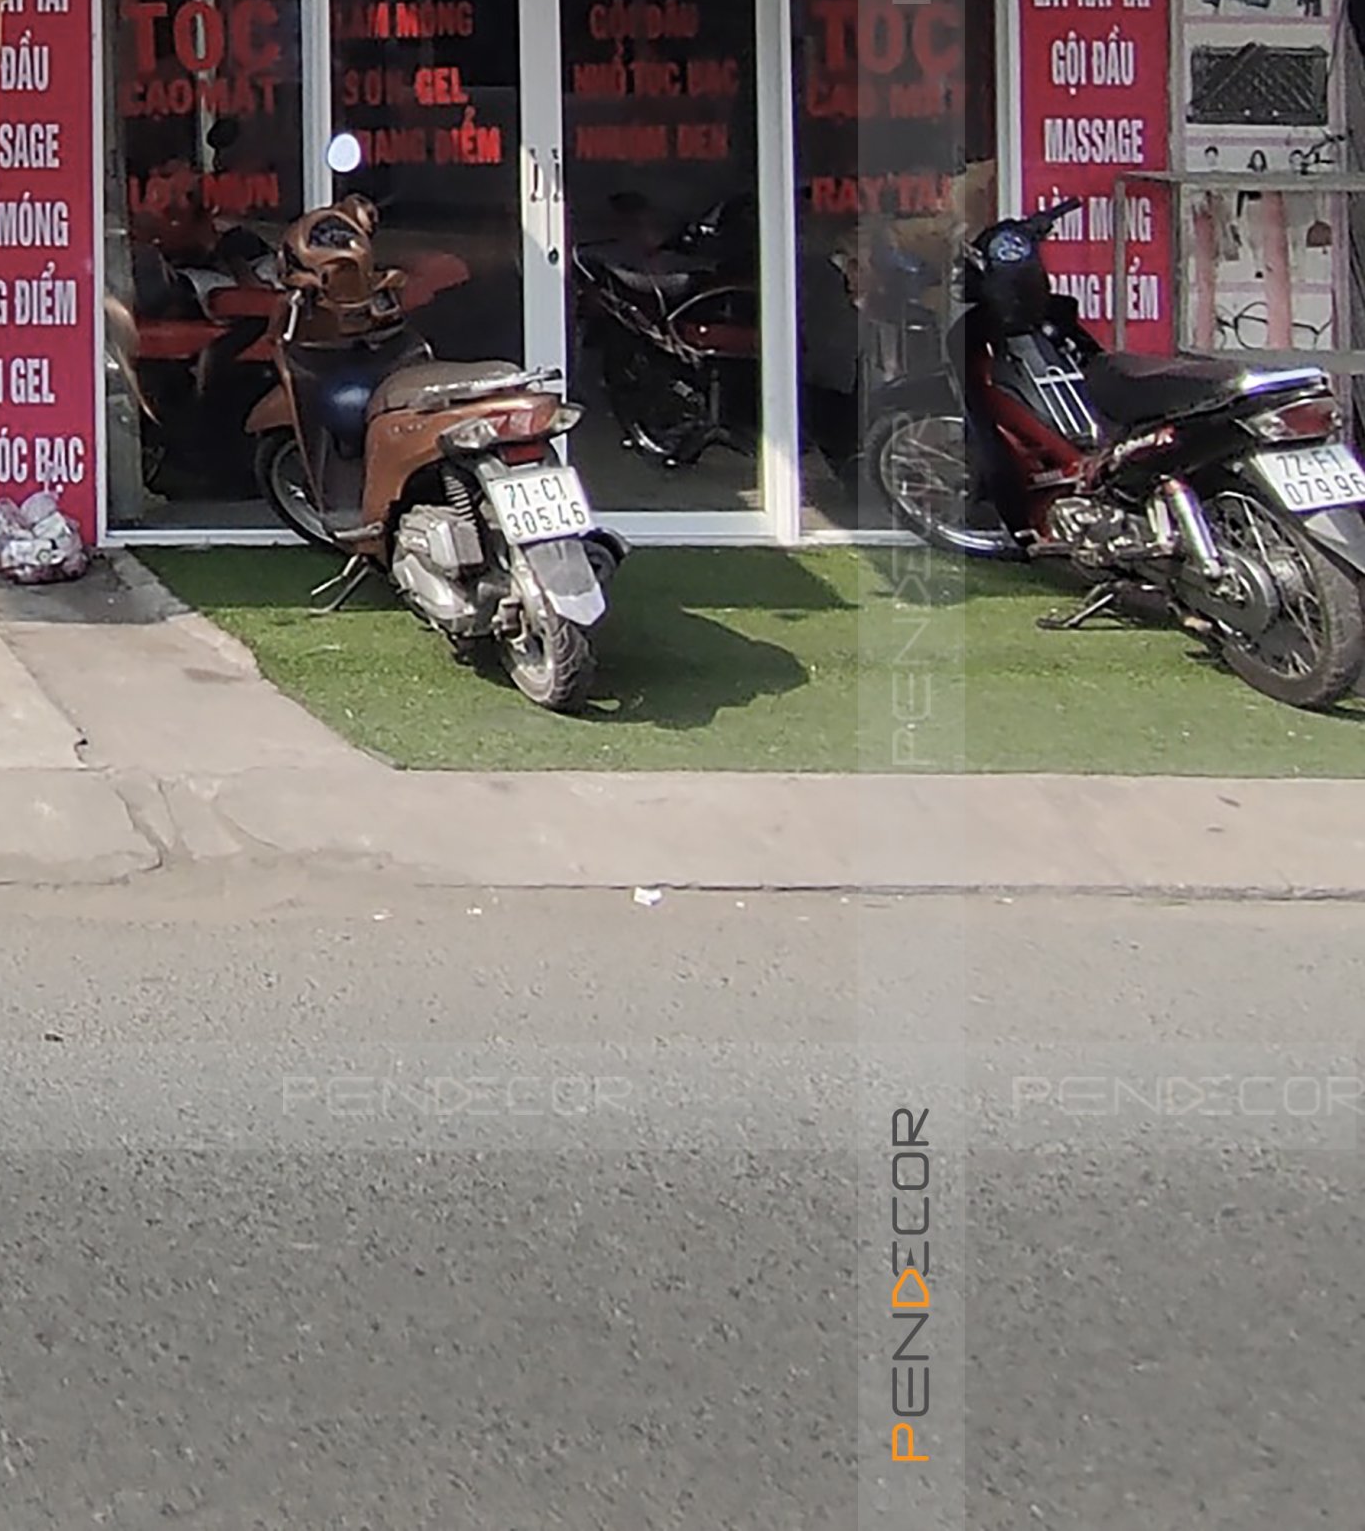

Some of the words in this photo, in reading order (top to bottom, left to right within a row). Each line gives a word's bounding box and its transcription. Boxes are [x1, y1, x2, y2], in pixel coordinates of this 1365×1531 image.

[0, 29, 49, 92] ĐẦU
[1051, 30, 1088, 95] GỘI
[1092, 24, 1136, 86] ĐẦU
[1043, 117, 1145, 166] MASSAGE
[14, 261, 78, 326] ĐIỂM
[9, 357, 56, 405] GEL
[34, 435, 84, 494] BẠC
